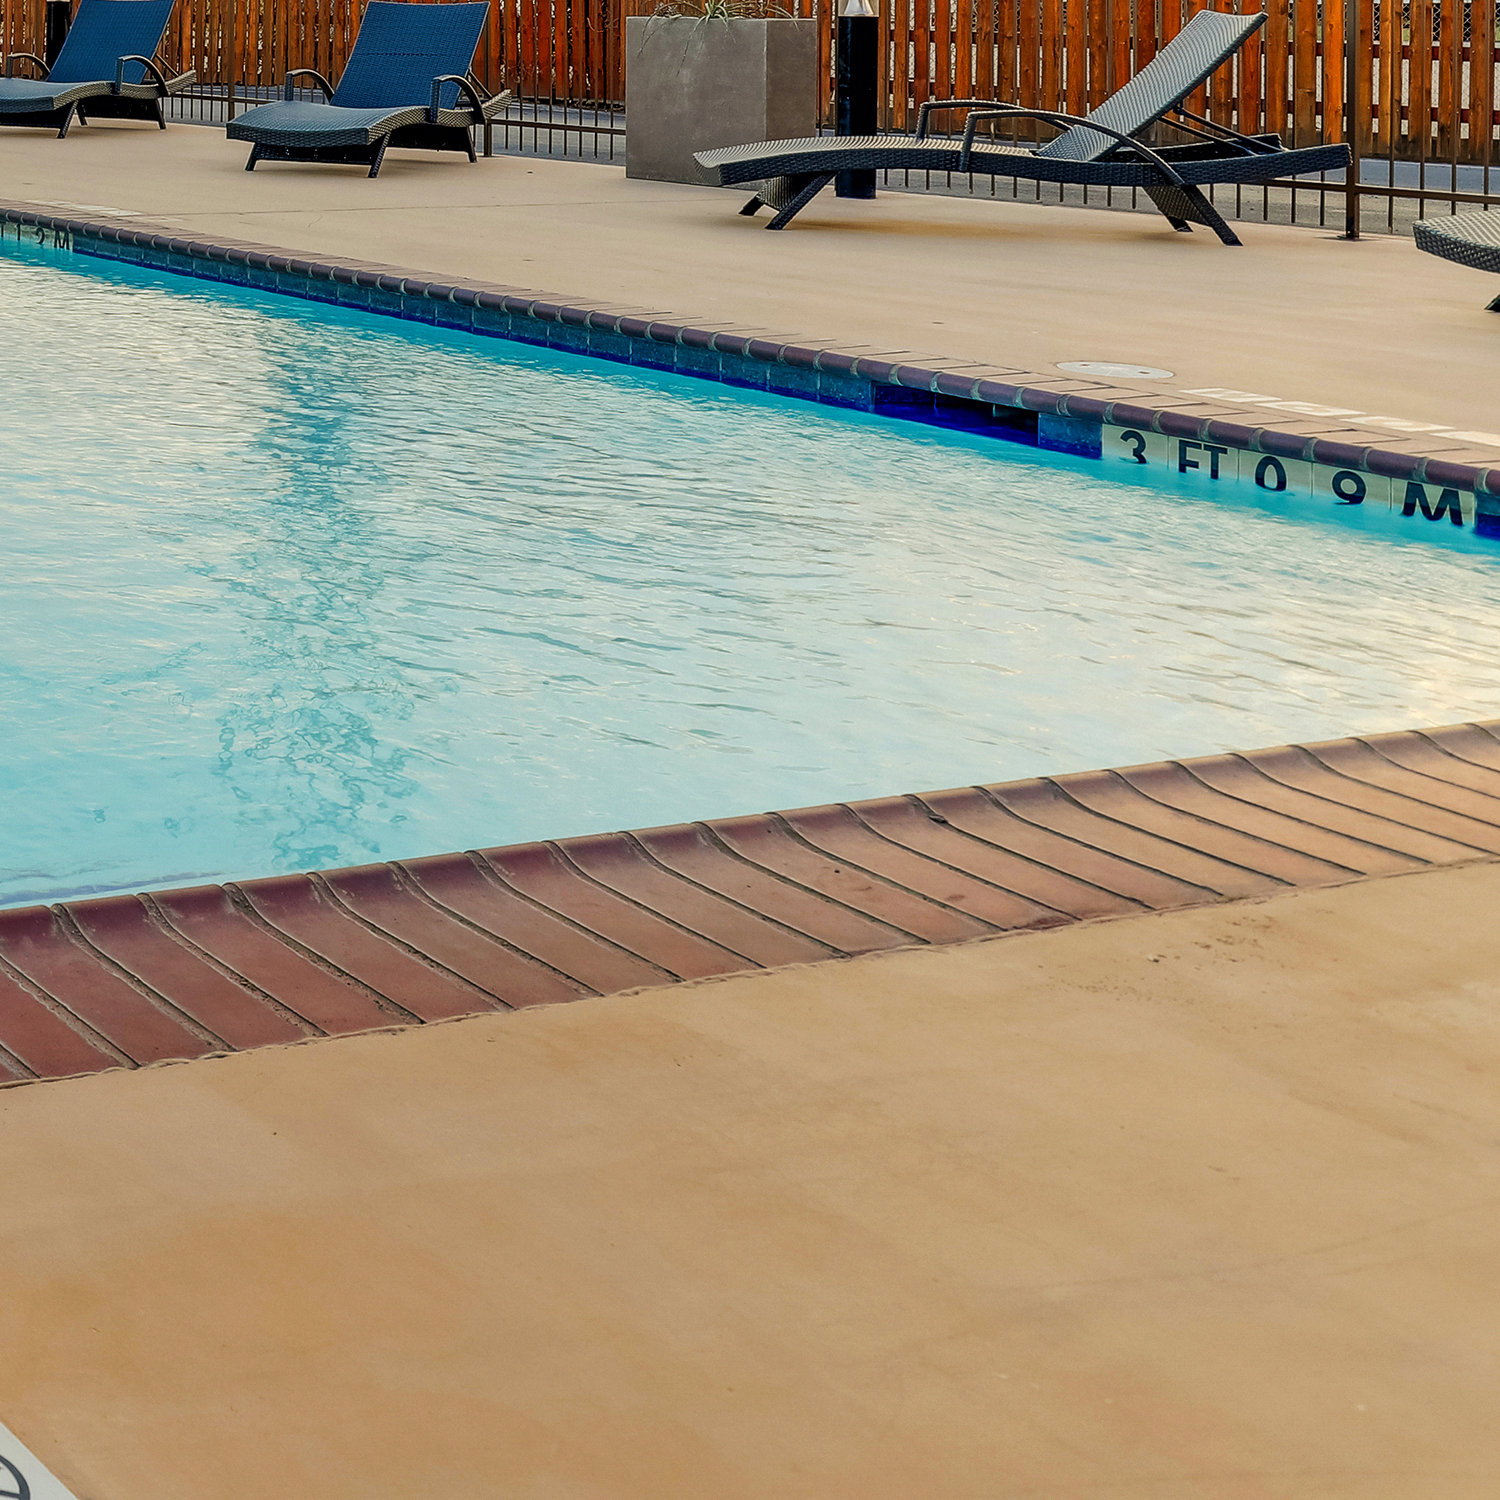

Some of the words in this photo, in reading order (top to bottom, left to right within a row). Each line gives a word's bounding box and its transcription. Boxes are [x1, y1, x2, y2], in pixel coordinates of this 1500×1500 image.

[1120, 429, 1148, 465] 3
[1178, 438, 1229, 481] FT
[1331, 470, 1367, 506] 9
[1401, 481, 1464, 527] M
